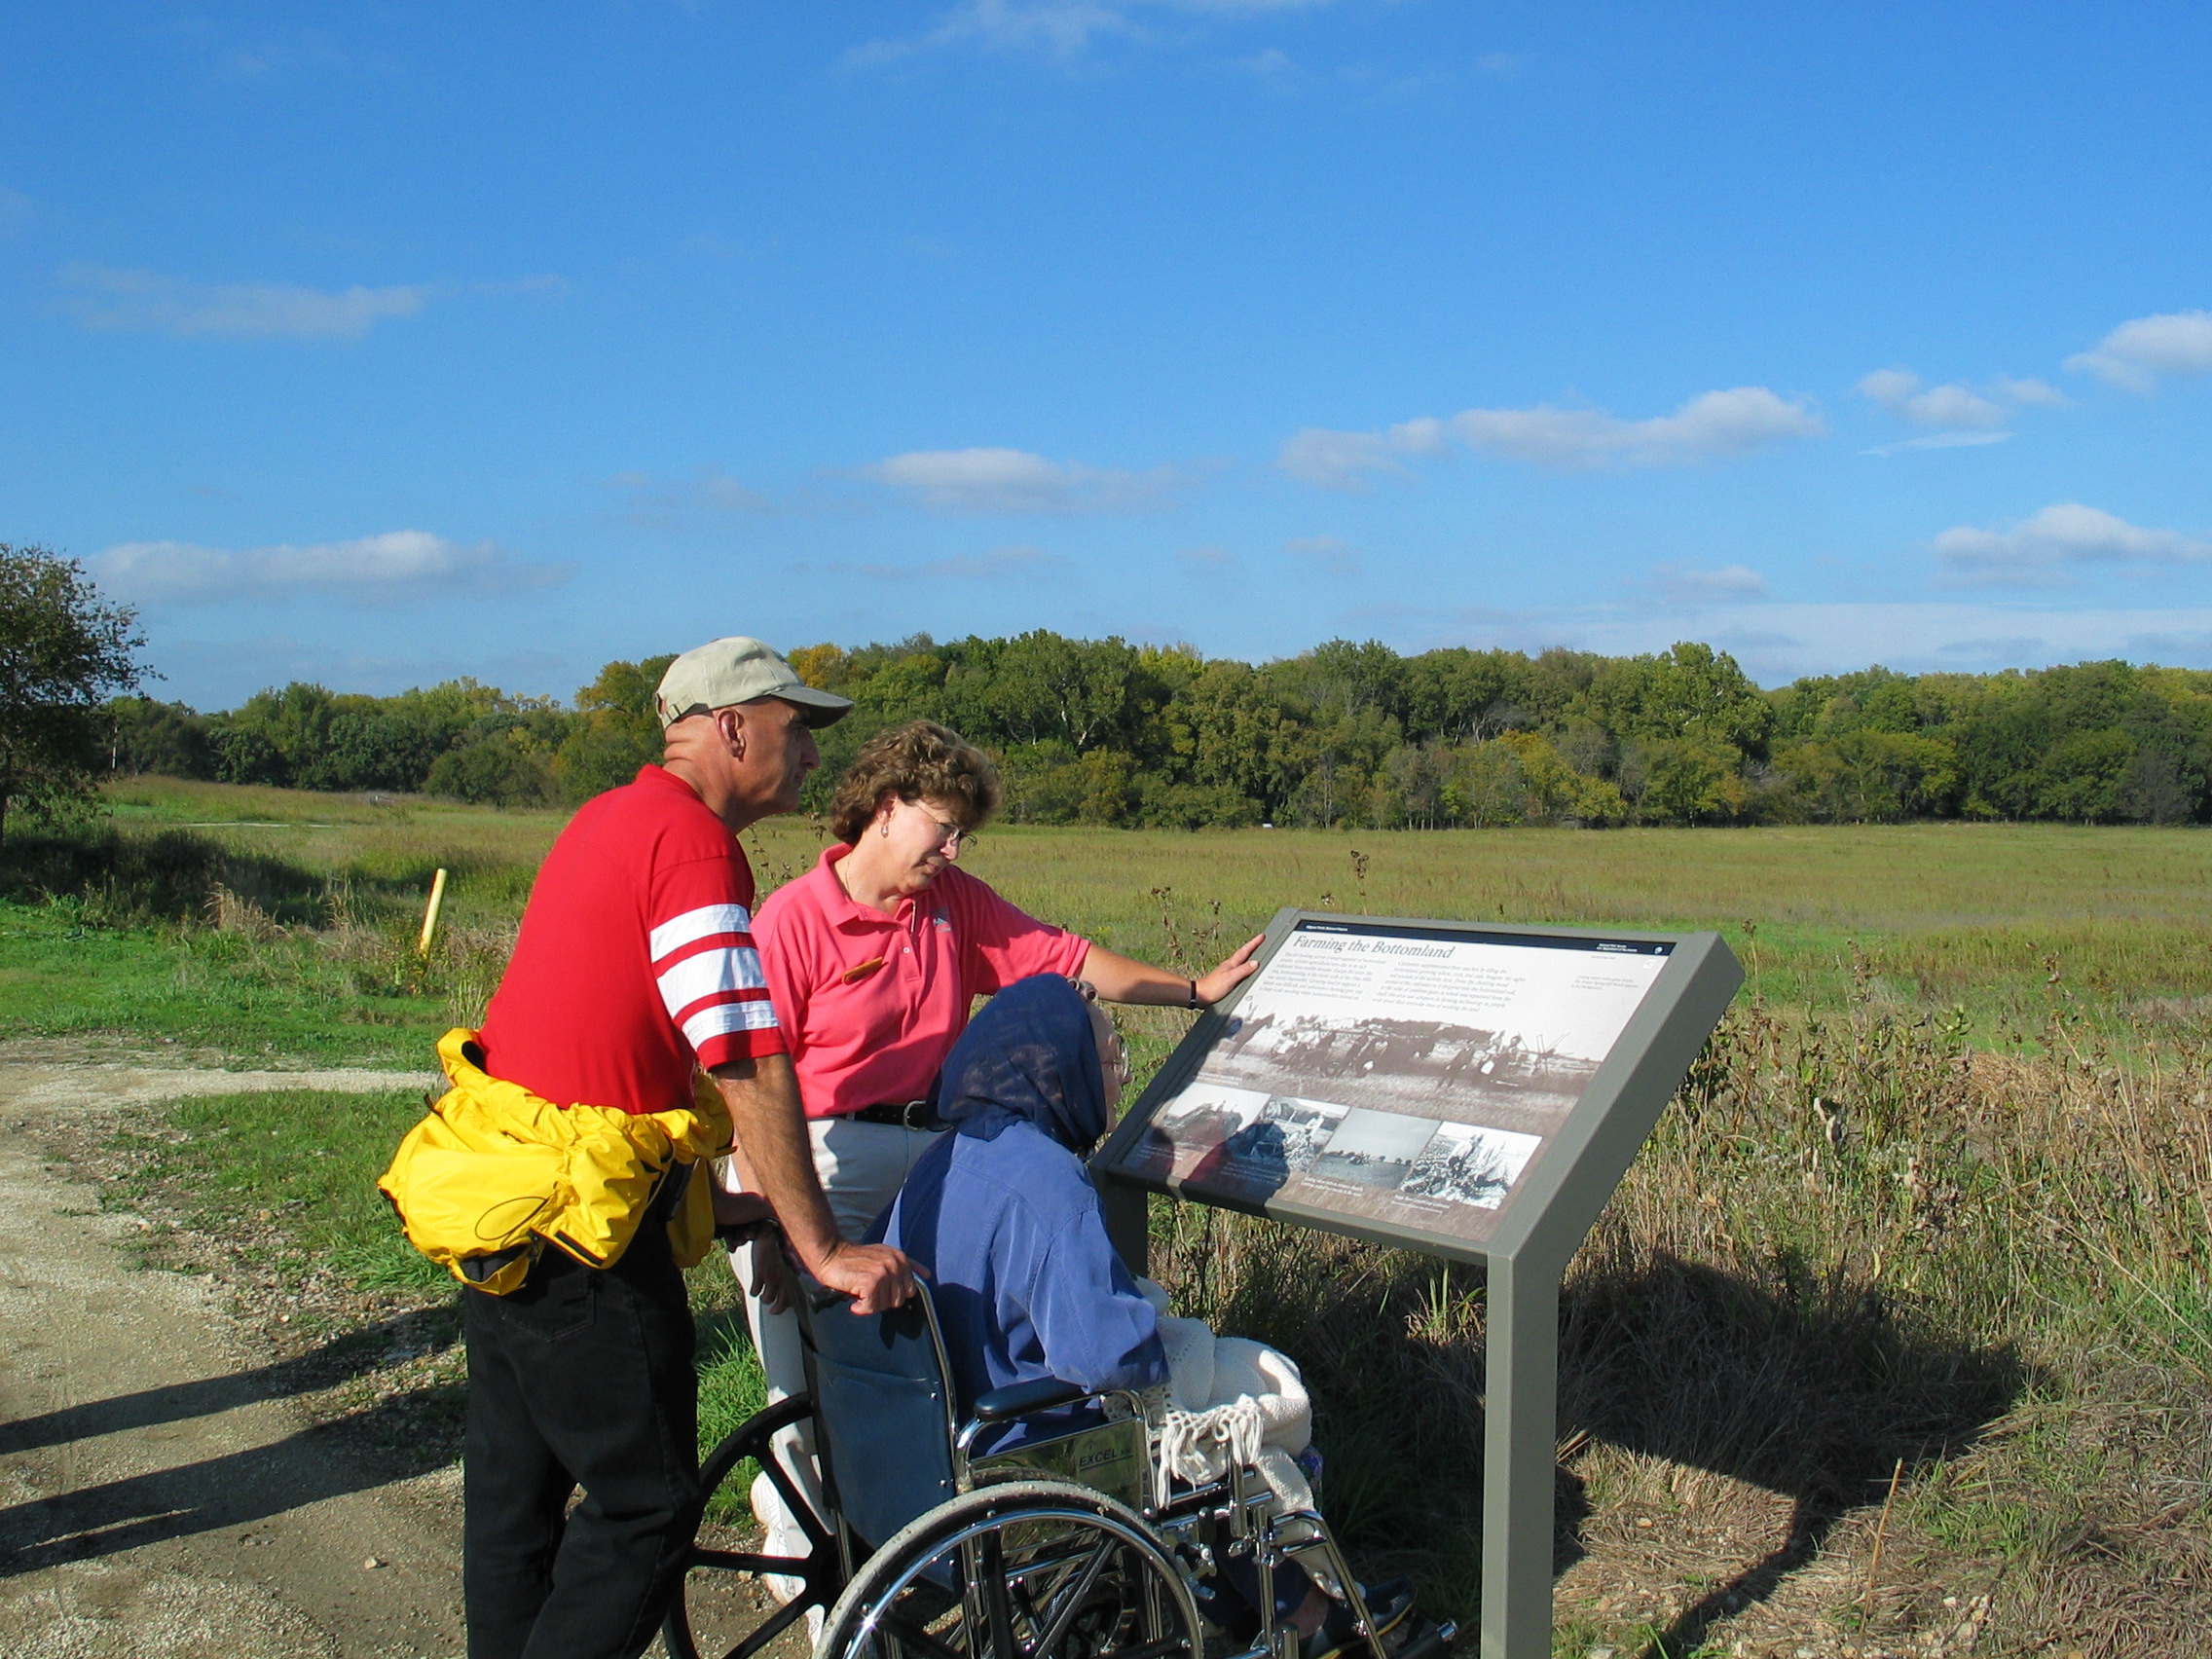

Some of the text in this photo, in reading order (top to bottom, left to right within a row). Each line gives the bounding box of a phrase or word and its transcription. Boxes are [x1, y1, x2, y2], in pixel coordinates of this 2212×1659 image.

[1293, 936, 1456, 959] Farming the Bottomland
[1080, 1449, 1118, 1466] EXCEL
